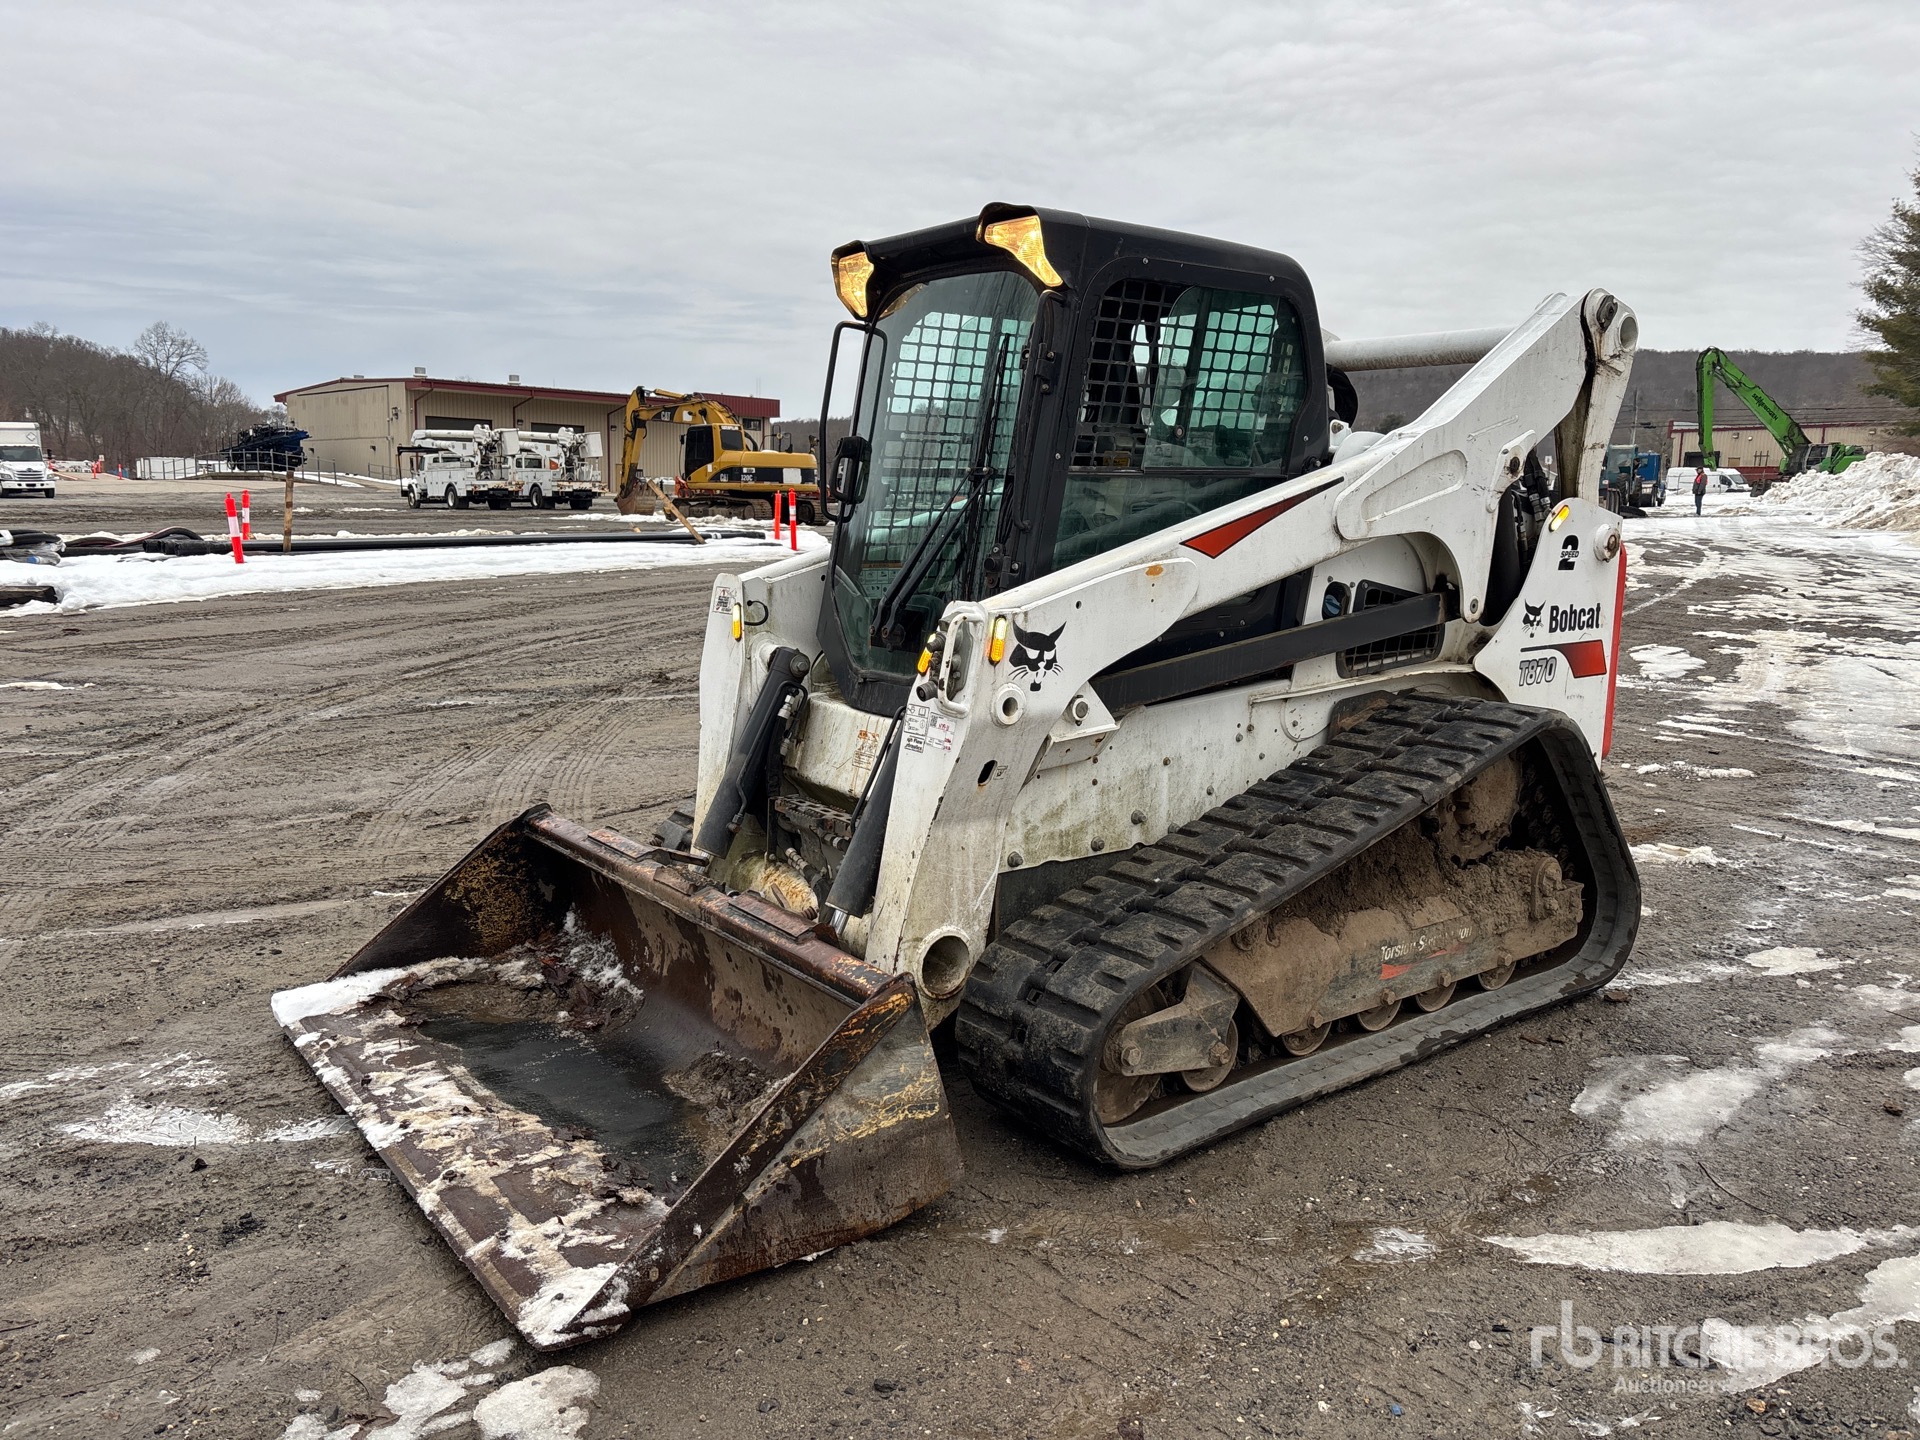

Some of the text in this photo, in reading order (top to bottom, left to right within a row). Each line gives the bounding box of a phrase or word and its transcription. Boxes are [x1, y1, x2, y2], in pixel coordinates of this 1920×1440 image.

[661, 411, 671, 420] CAT
[720, 473, 729, 482] CAT
[1558, 534, 1579, 571] 2
[1560, 550, 1580, 558] SPEED
[1548, 602, 1601, 633] Bobcat
[1518, 656, 1557, 687] T870
